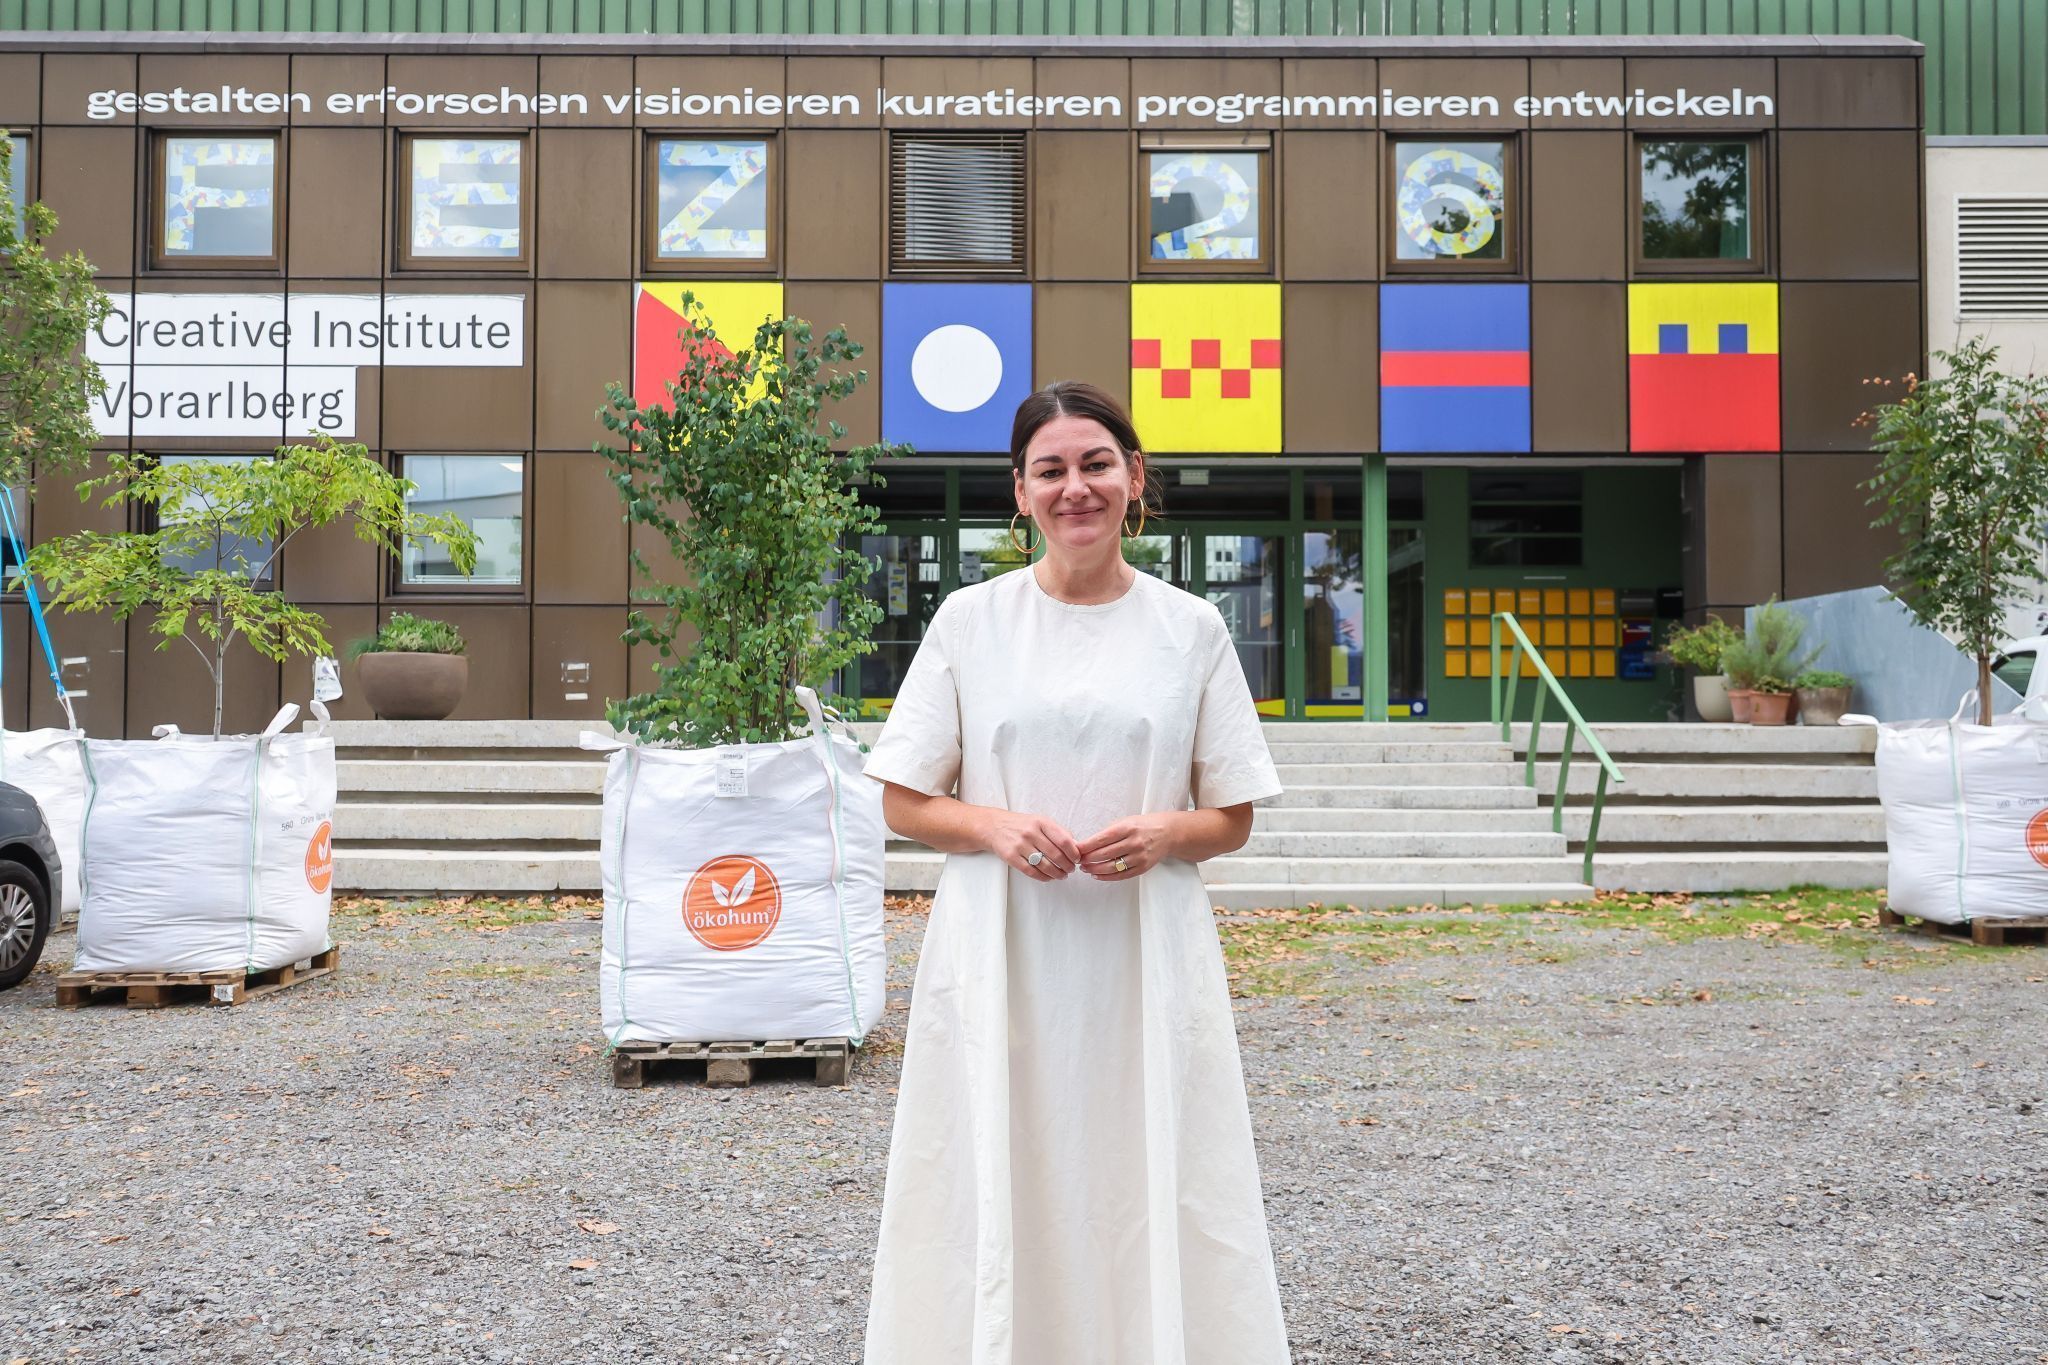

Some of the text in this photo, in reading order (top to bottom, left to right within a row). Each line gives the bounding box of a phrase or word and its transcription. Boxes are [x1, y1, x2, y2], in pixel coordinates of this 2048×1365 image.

[86, 85, 1774, 124] gestalten erforschen visionieren kuratieren programmieren entwickeln
[98, 309, 511, 349] Creative Institute
[101, 380, 344, 430] Vorarlberg
